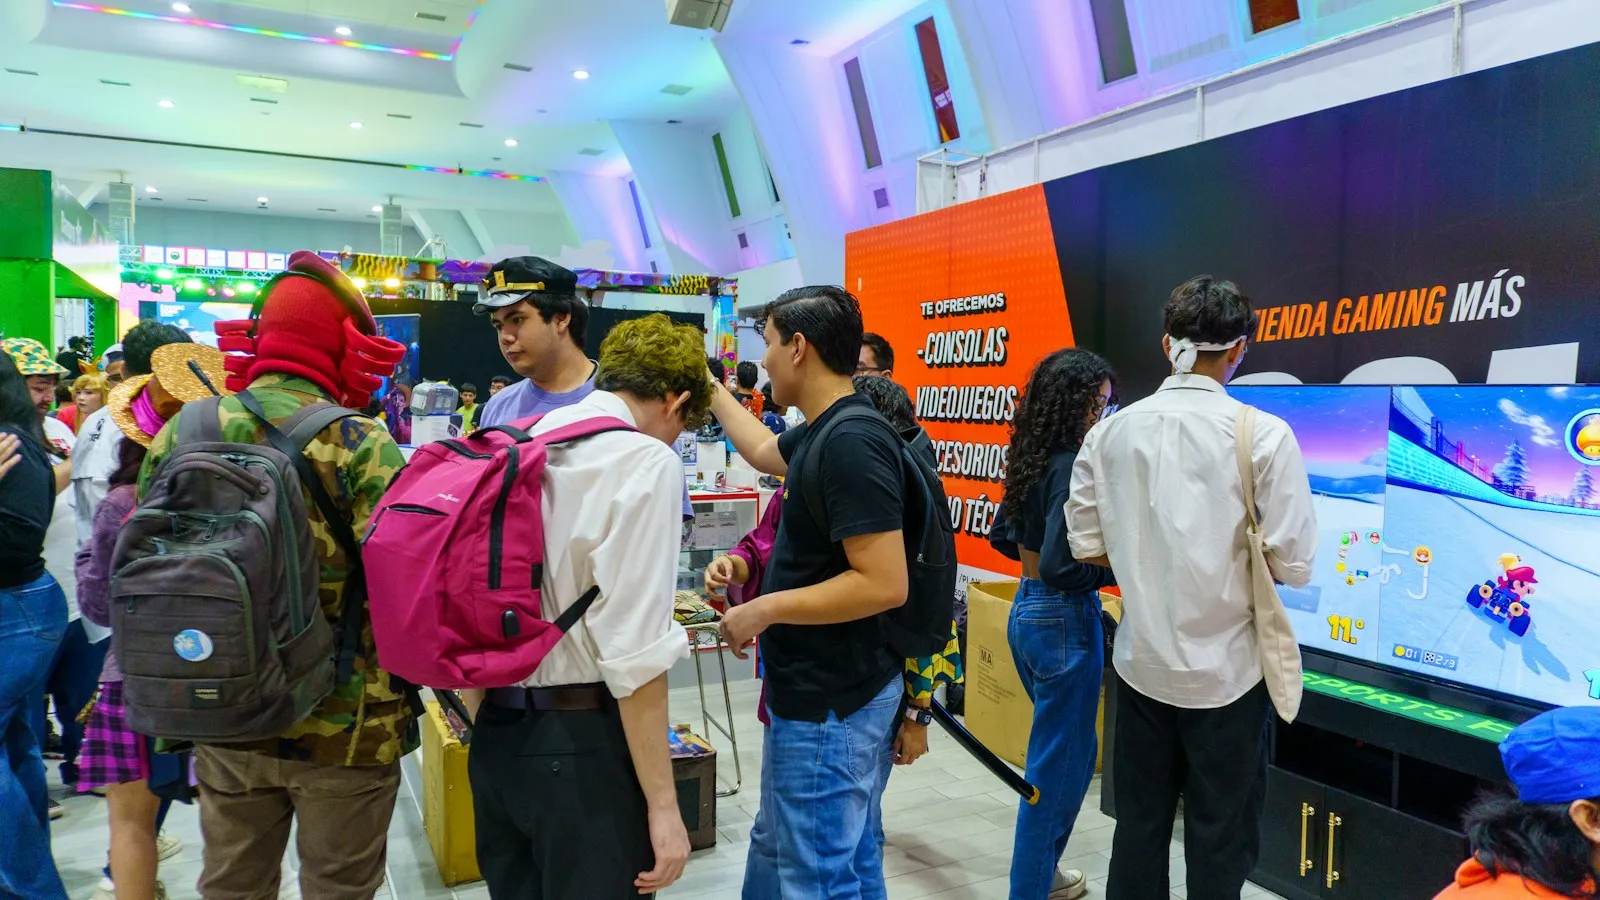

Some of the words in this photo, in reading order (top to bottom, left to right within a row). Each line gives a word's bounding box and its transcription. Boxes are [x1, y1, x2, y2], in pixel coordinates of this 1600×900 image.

[920, 301, 934, 318] TE
[935, 292, 1006, 316] OFRECEMOS
[1332, 285, 1447, 335] GAMING
[1450, 268, 1526, 323] MÁS
[917, 326, 1008, 366] -CONSOLAS
[916, 385, 1018, 421] VIDEOJUEGOS
[980, 649, 992, 666] MA
[1435, 656, 1457, 668] 2/3
